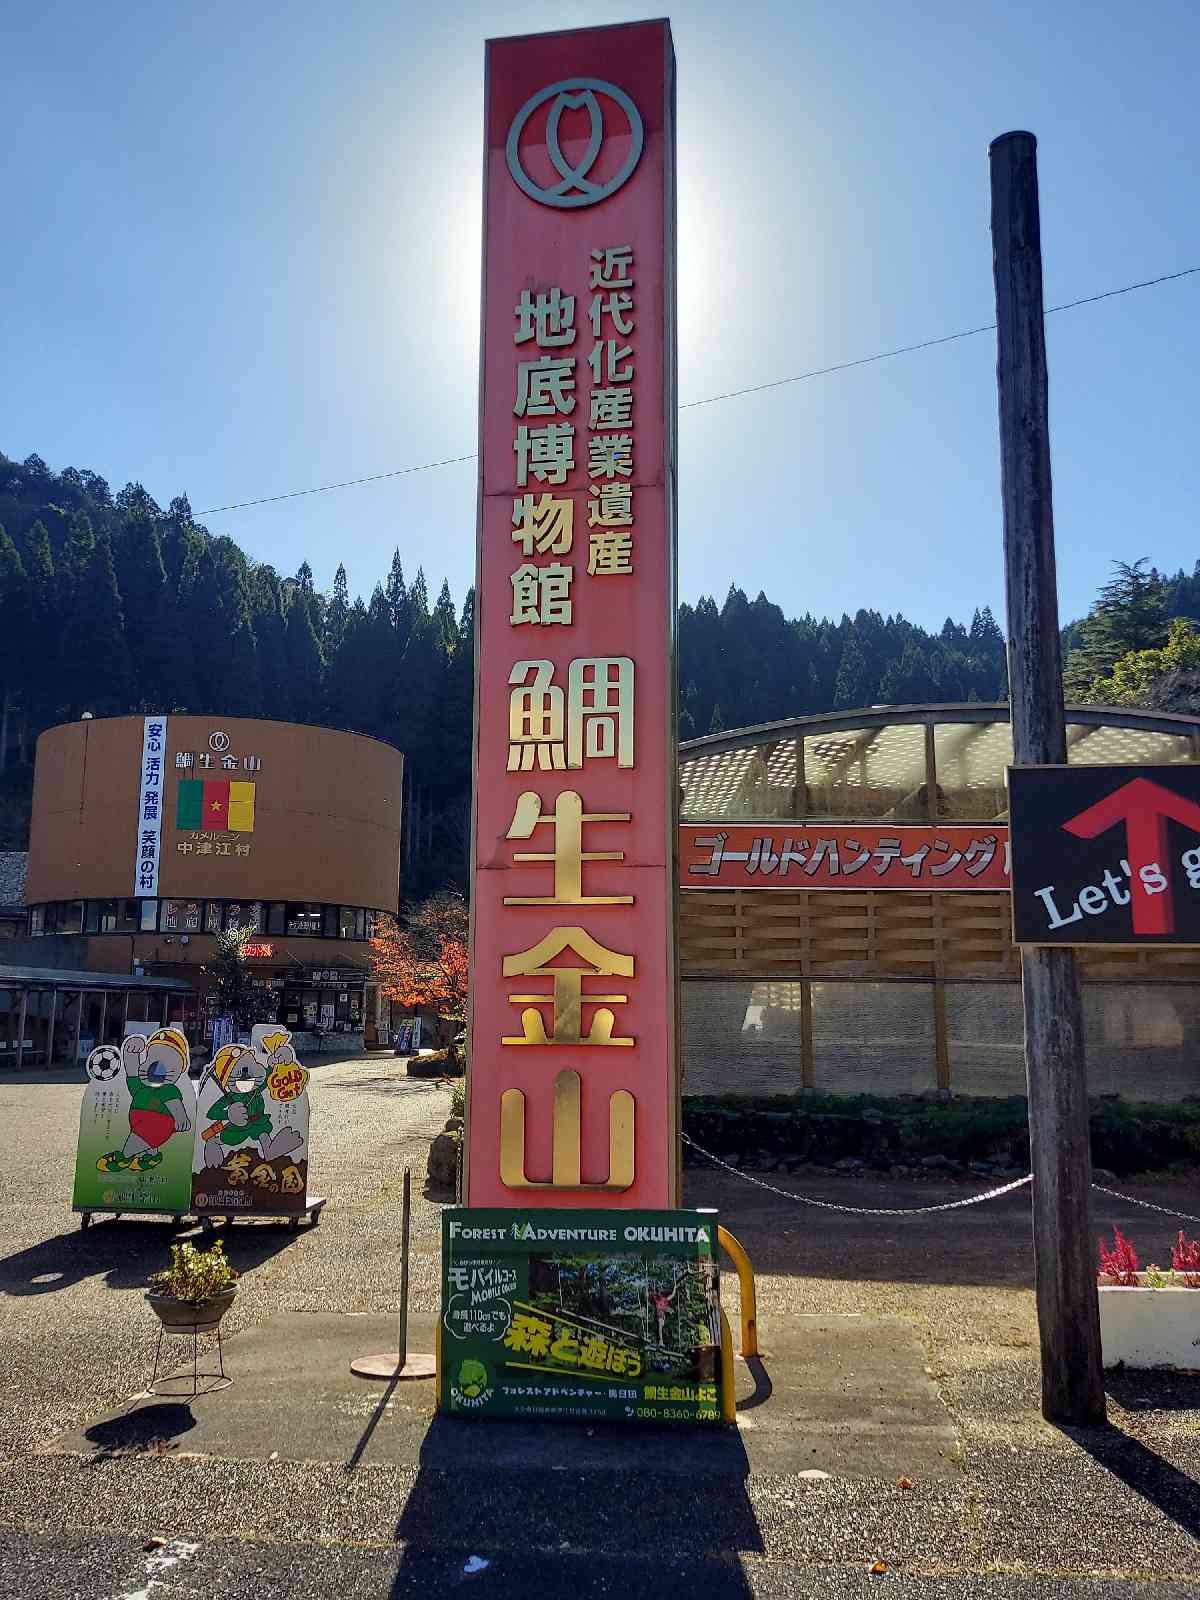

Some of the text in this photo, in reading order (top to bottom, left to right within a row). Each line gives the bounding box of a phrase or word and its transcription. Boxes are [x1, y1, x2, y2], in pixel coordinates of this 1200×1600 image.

[587, 245, 635, 576] 近代化産業遺産
[509, 287, 577, 628] 地底博物館
[175, 751, 261, 771] 鯛生金山
[139, 723, 163, 889] 安心 活力 発展 笑顔の村
[177, 841, 251, 857] 中津江村
[688, 831, 1010, 878] ゴールドハンティング
[500, 656, 636, 1193] 鯛生金山
[1033, 859, 1168, 930] Let's
[623, 1226, 710, 1243] OKUHITA
